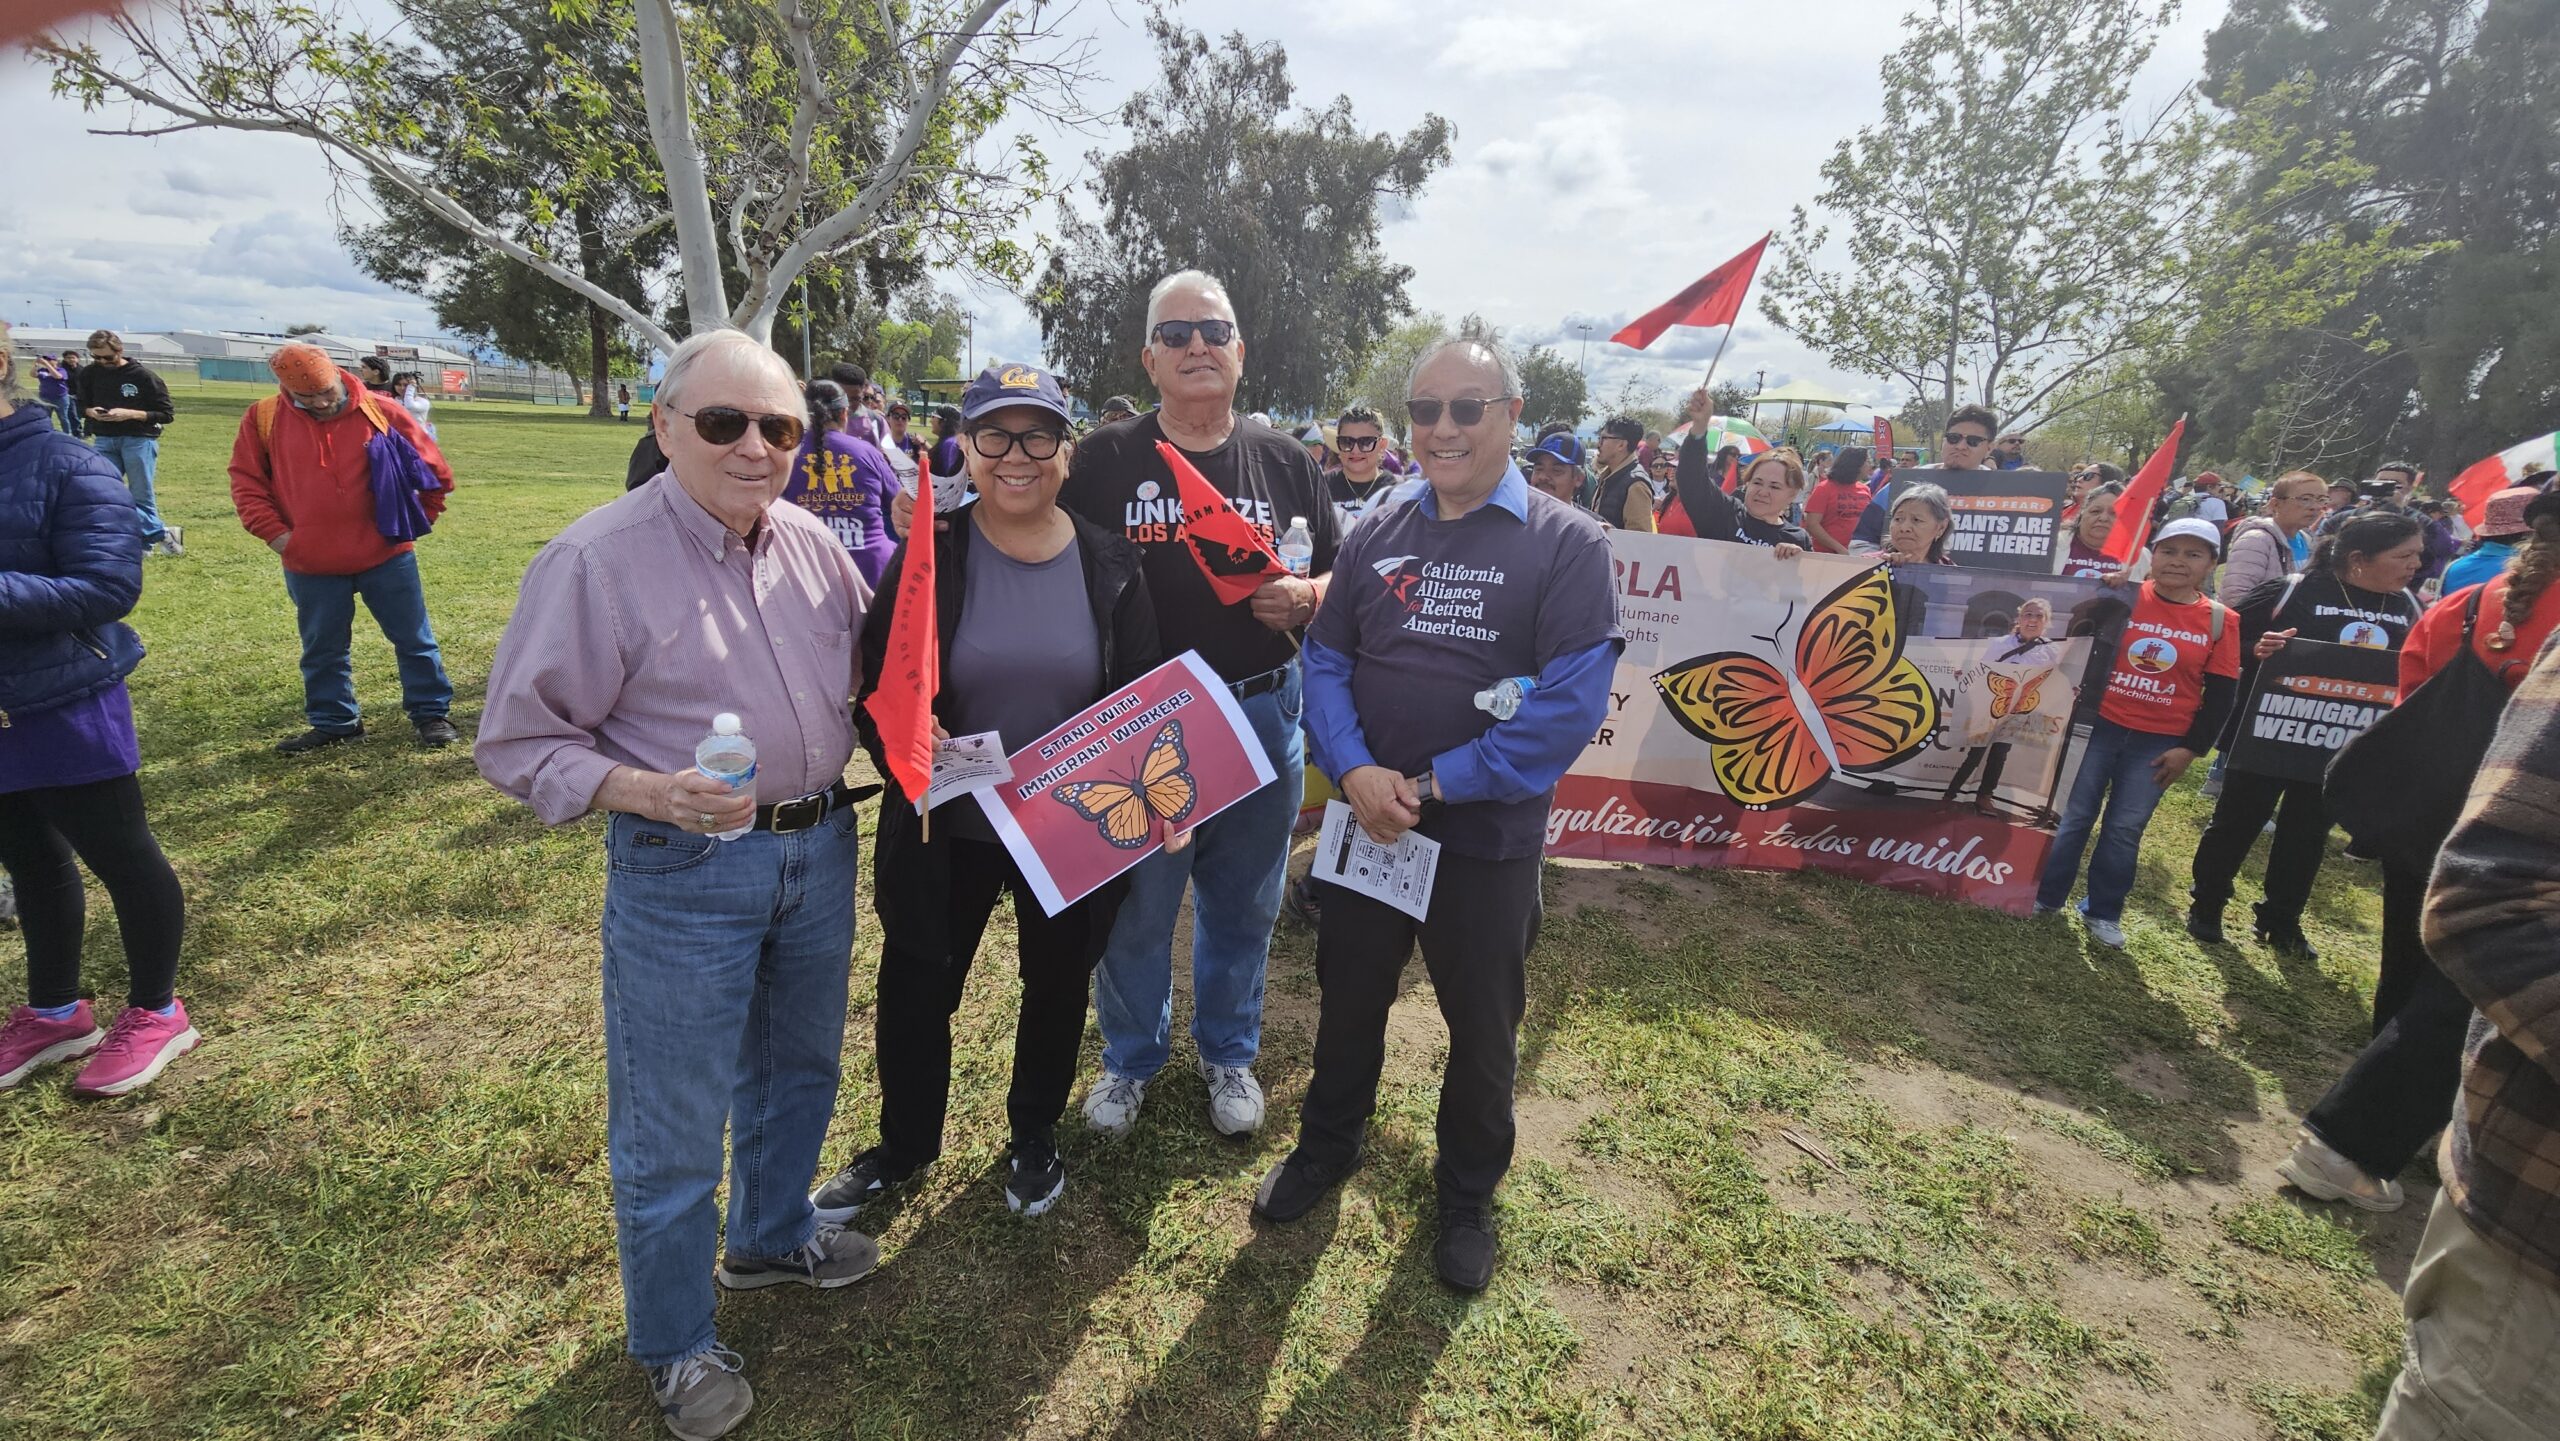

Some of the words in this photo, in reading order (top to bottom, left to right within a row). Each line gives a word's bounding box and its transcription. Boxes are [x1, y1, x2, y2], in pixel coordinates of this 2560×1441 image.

[1000, 367, 1040, 390] Cal
[1948, 498, 1970, 509] TE,
[1976, 499, 1997, 509] NO
[2002, 500, 2046, 511] FEAR:
[1183, 504, 1214, 529] ARM
[1952, 513, 2011, 534] RANTS
[2012, 516, 2054, 535] ARE
[1126, 523, 1167, 543] LOS
[1949, 532, 1986, 553] ME
[1988, 534, 2051, 556] HERE!
[1421, 561, 1505, 585] California
[2066, 557, 2122, 570] -migra
[1414, 580, 1482, 601] Alliance
[1615, 559, 1683, 602] RLA
[1419, 597, 1484, 620] Retired
[1621, 626, 1660, 644] ights
[2282, 676, 2311, 689] NO
[2318, 681, 2374, 700] HATE,
[2382, 690, 2397, 702] N
[1039, 720, 1098, 761] STAND
[1094, 692, 1142, 727] WITH
[1016, 737, 1110, 802] IMMIGRANT
[1108, 688, 1195, 744] WORKERS
[1545, 795, 1749, 849] galización,
[1758, 823, 1860, 856] todos
[1866, 834, 2015, 886] unidos
